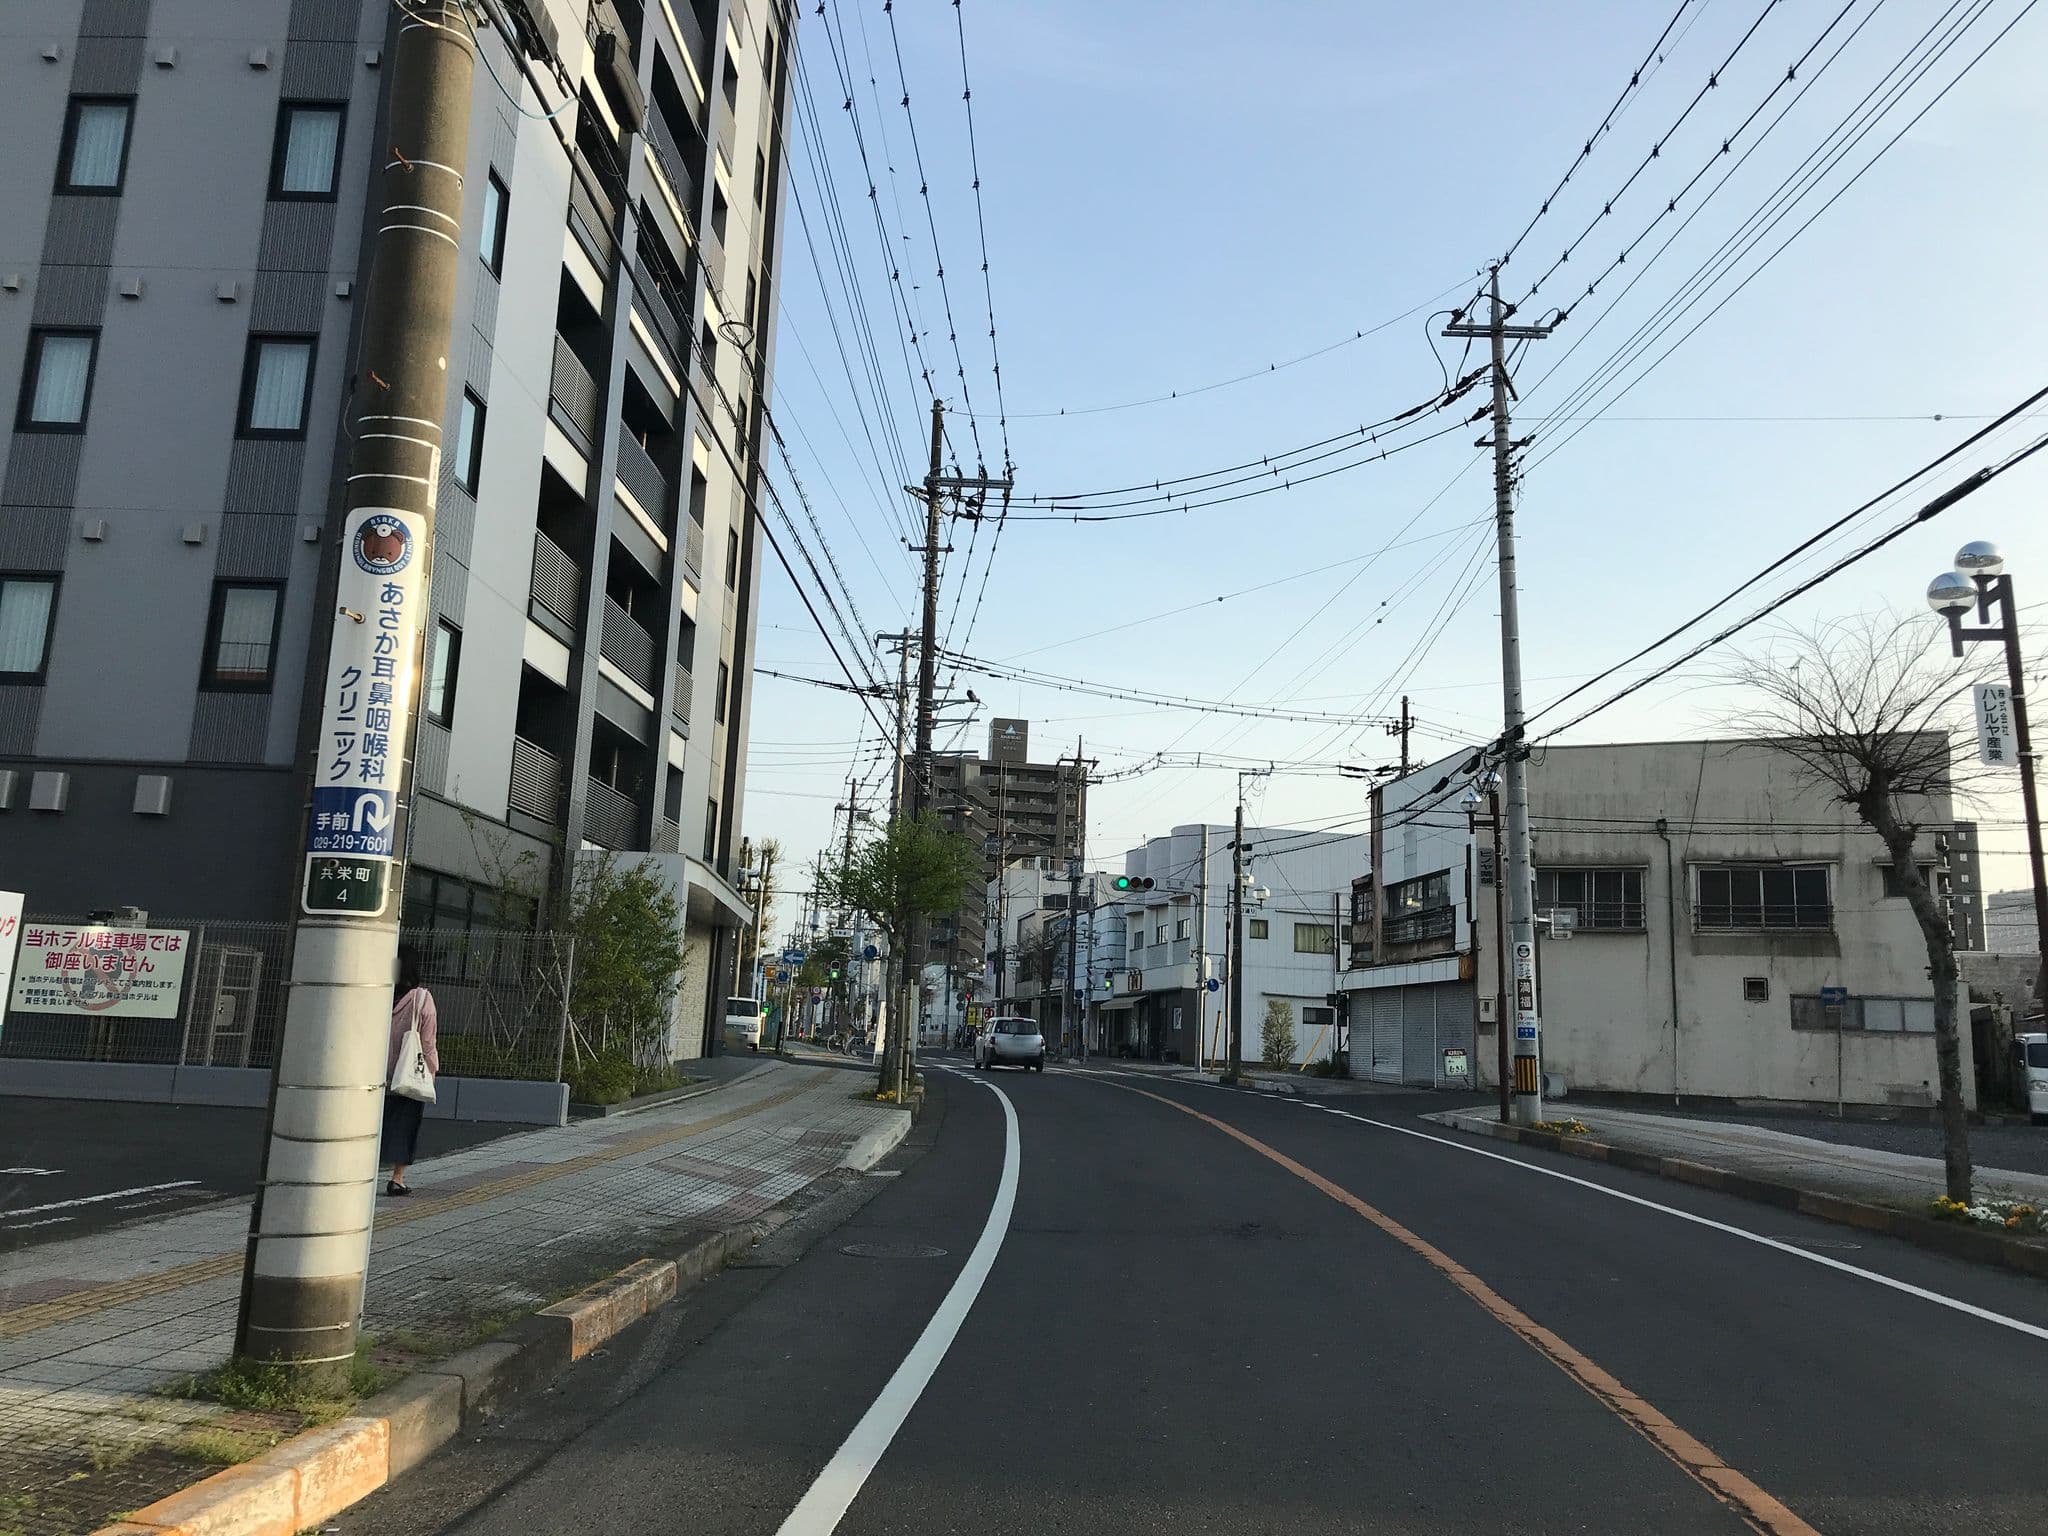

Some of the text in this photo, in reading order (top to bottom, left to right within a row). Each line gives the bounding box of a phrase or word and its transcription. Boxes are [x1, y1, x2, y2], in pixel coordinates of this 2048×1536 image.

[369, 516, 402, 528] ASAKA
[359, 581, 405, 785] あさか耳鼻咽喉科
[329, 665, 361, 782] クリニック
[1983, 689, 2004, 760] ハレルヤ産業
[317, 812, 351, 832] 手前
[313, 833, 389, 853] 029-219-7601
[320, 866, 371, 882] 共栄町
[336, 888, 348, 903] 4
[25, 929, 182, 952] 当ホテル駐車場では
[45, 952, 155, 973] 御座いません
